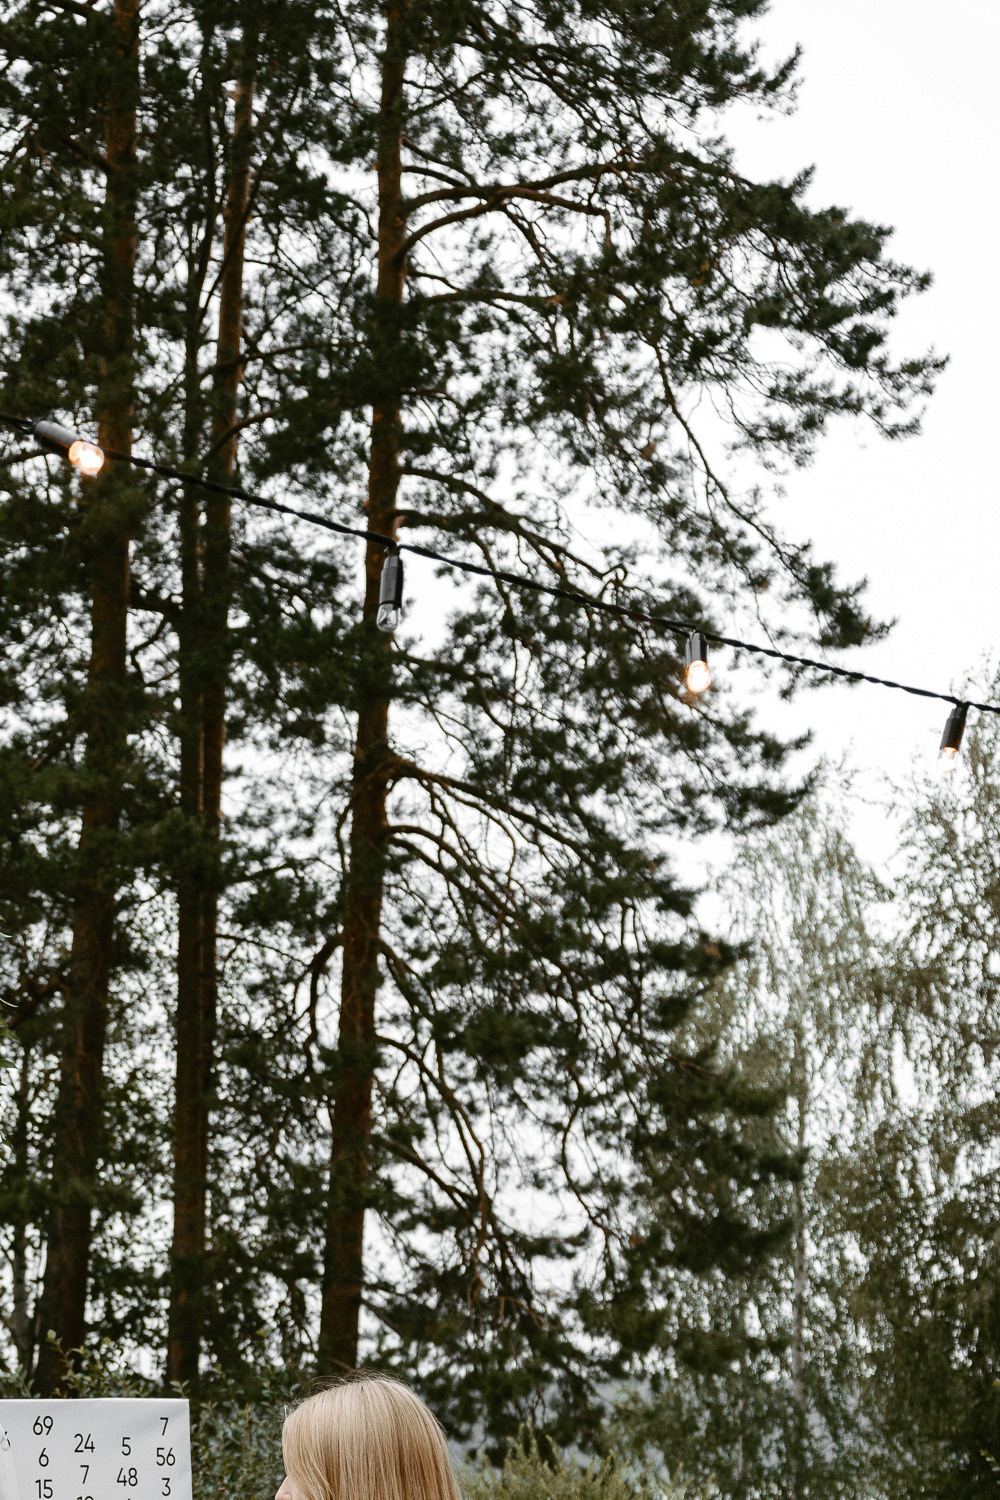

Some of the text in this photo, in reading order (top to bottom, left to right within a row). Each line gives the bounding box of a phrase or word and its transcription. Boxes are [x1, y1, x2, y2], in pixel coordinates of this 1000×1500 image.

[33, 1416, 53, 1435] 69
[160, 1417, 168, 1435] 7
[74, 1434, 95, 1453] 24
[122, 1437, 131, 1456] 5
[39, 1448, 49, 1467] 6
[156, 1448, 175, 1466] 56
[80, 1465, 89, 1484] 7
[117, 1468, 138, 1486] 48
[35, 1479, 53, 1498] 15
[162, 1478, 170, 1496] 3
